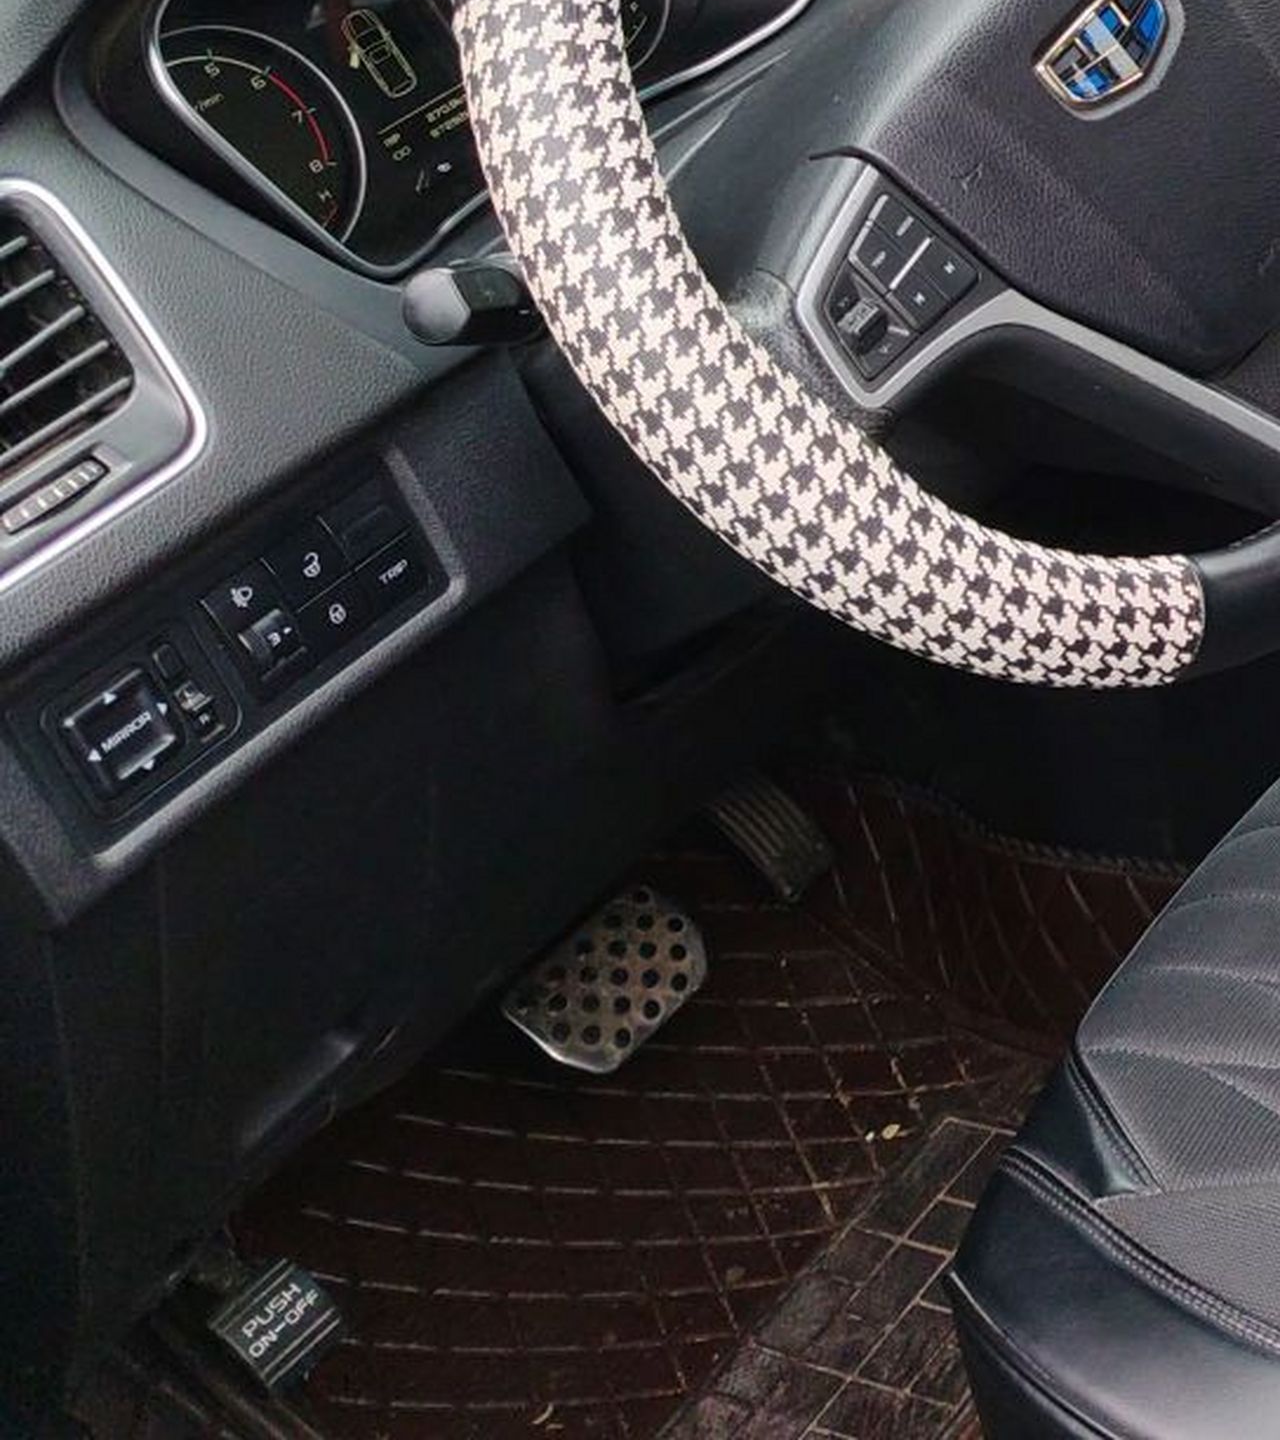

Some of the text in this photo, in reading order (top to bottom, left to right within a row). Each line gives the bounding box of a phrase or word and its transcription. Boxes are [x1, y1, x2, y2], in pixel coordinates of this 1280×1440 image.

[203, 62, 221, 78] 5
[249, 75, 267, 91] 6
[291, 109, 305, 124] 7
[308, 159, 324, 174] 8
[378, 558, 409, 585] TRIP
[100, 710, 152, 753] MIRROR
[241, 1282, 302, 1338] PUSH
